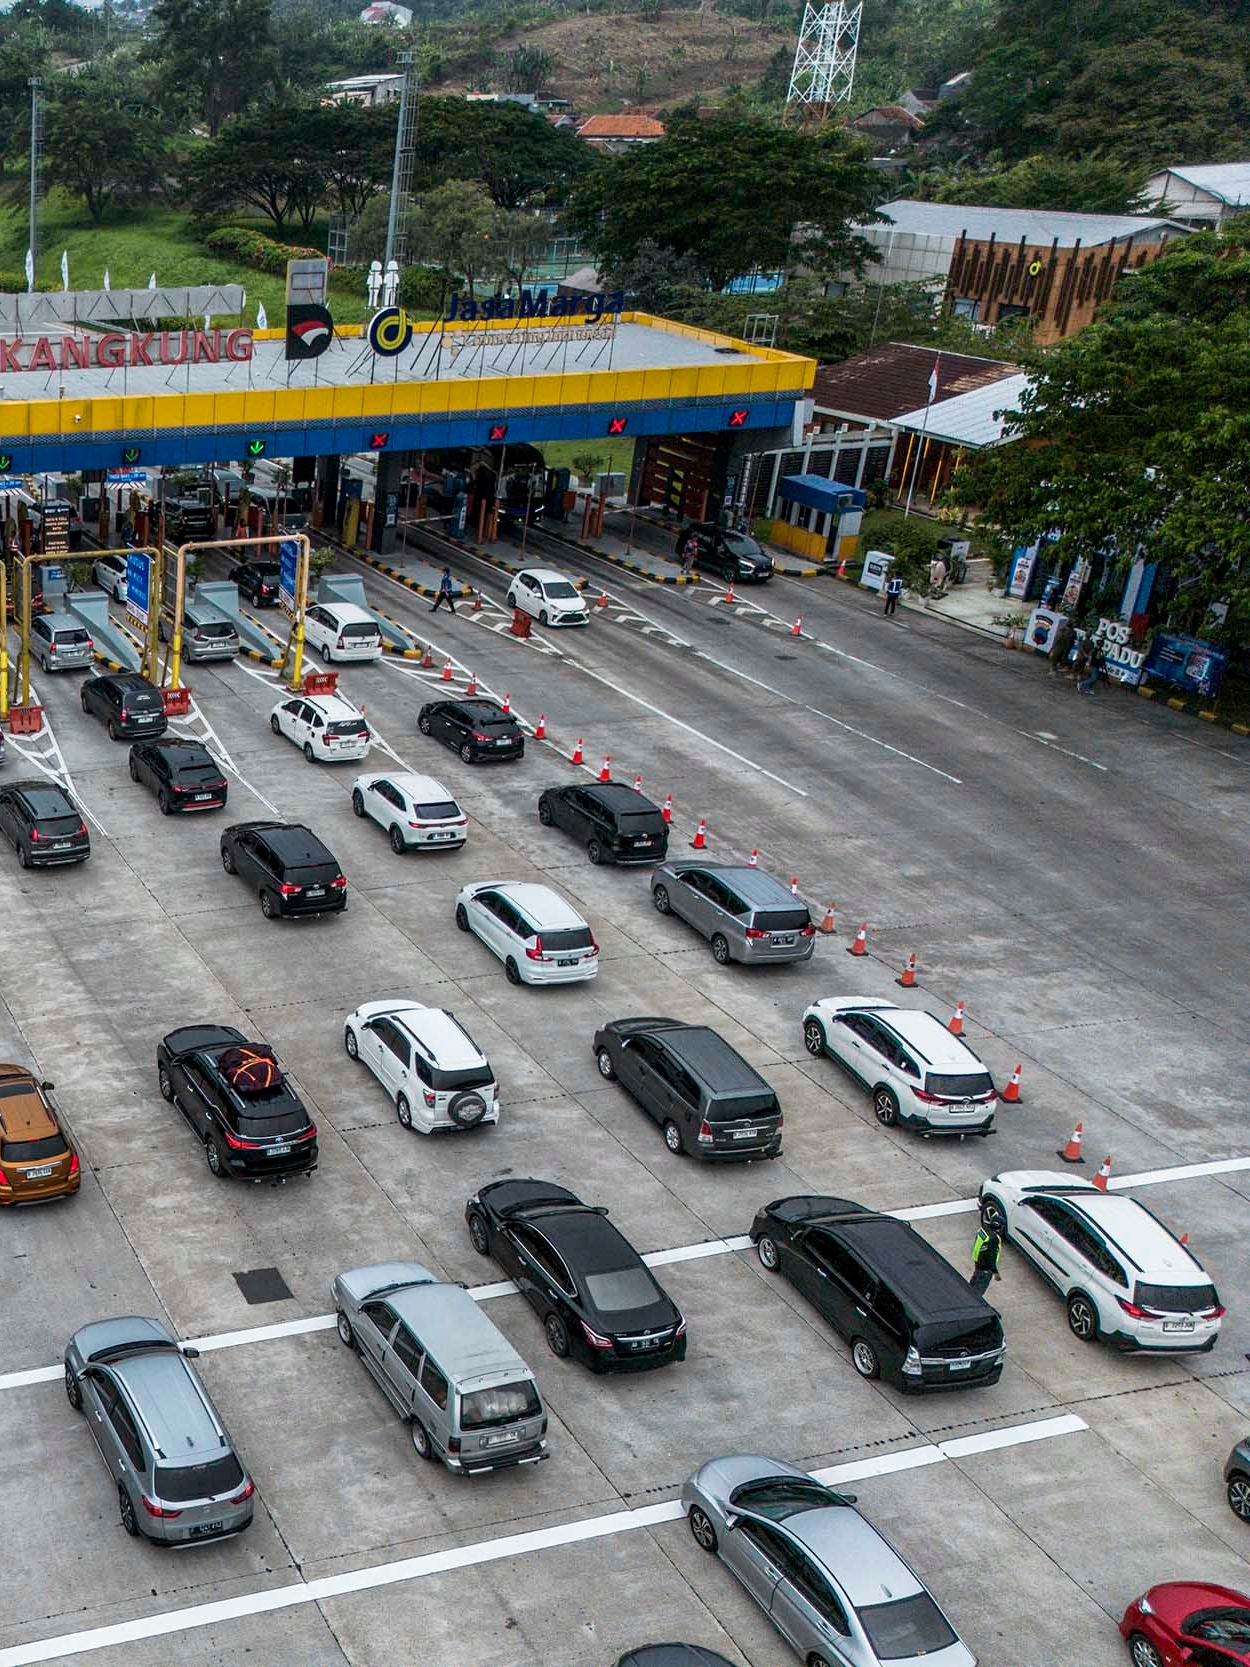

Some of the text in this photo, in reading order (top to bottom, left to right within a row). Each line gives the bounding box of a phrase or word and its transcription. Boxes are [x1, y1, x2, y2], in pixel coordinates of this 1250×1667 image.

[443, 287, 626, 324] Jasa Marga
[1096, 617, 1133, 645] POS
